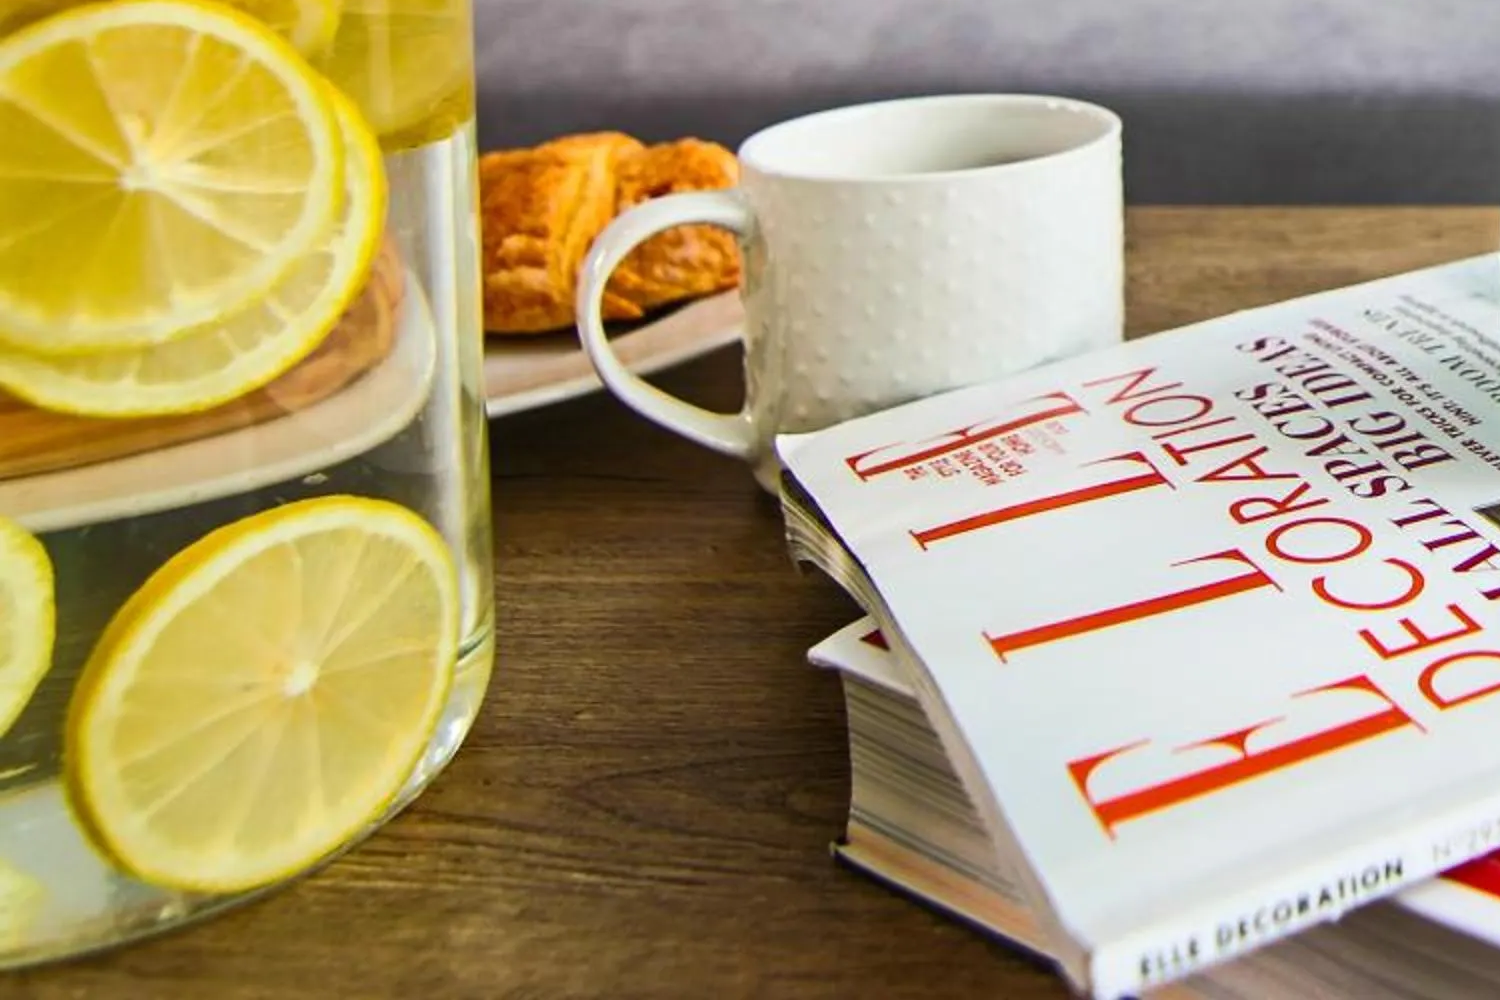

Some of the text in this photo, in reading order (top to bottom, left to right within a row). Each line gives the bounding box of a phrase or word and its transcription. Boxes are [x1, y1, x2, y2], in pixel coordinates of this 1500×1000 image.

[1235, 336, 1376, 409] IDEAS
[1338, 351, 1395, 392] COMPACT
[1356, 343, 1400, 368] ABOUT
[1398, 367, 1420, 384] ALL
[1415, 382, 1444, 402] IT'S
[1390, 388, 1417, 408] FOR
[1442, 399, 1482, 427] HINT:
[1233, 382, 1414, 499] SPACES
[1414, 405, 1464, 439] TRICKS
[1345, 410, 1457, 472] BIG
[845, 391, 1428, 841] ELLE
[1139, 934, 1199, 978] ELLE
[1215, 858, 1404, 949] DECORATION
